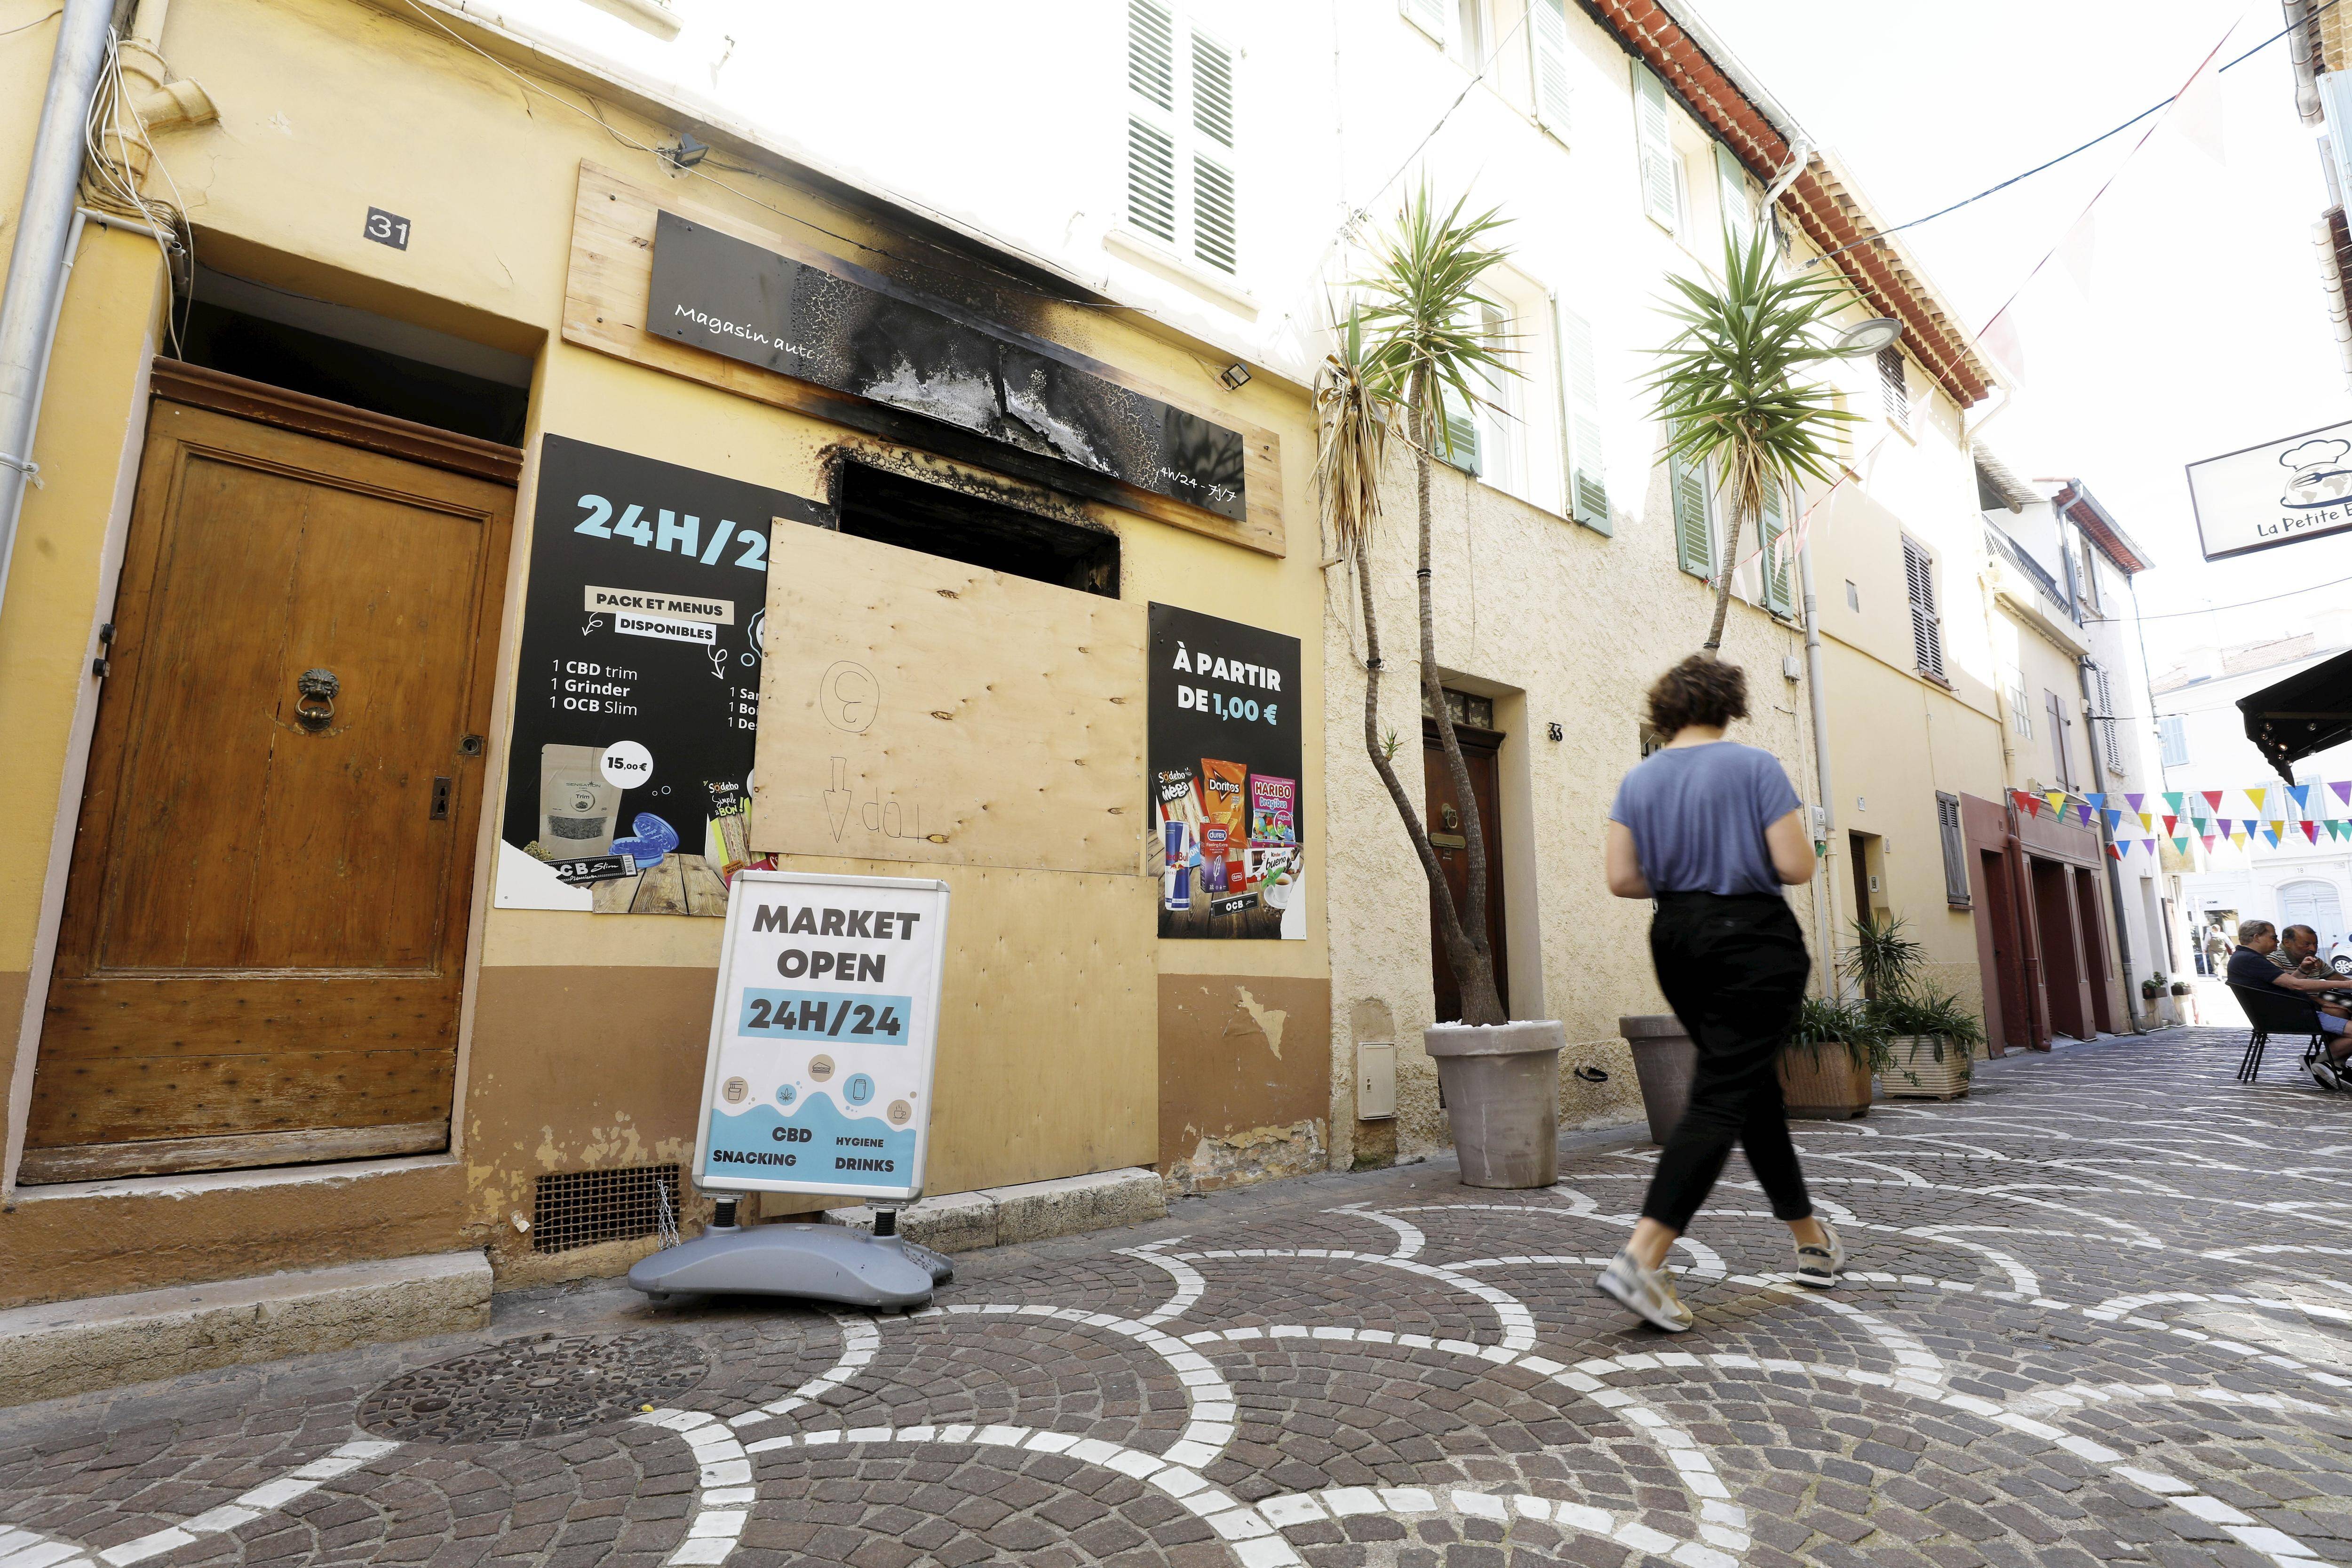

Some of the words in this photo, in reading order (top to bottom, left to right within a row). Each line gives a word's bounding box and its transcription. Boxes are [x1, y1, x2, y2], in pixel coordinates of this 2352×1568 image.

[369, 215, 407, 245] 31
[675, 303, 769, 344] Magasin
[774, 338, 816, 359] auto
[1160, 466, 1198, 489] 4h/24
[2257, 524, 2278, 537] La
[2282, 509, 2339, 532] Petite
[573, 493, 767, 572] 24H/2
[596, 593, 643, 610] PACK
[646, 597, 664, 611] ET
[667, 598, 723, 616] MENUS
[620, 618, 713, 640] DISPONIBLES
[553, 659, 559, 672] 1
[566, 661, 601, 676] CBD
[605, 662, 638, 681] trim
[1173, 640, 1192, 673] À
[1197, 652, 1281, 692] PARTIR
[551, 677, 557, 691] 1
[564, 679, 630, 697] Grinder
[730, 686, 735, 697] 1
[549, 695, 556, 708] 1
[563, 698, 599, 712] OCB
[604, 700, 637, 716] Slim
[729, 701, 734, 712] 1
[739, 703, 759, 715] Boi
[1178, 685, 1208, 712] DE
[1213, 693, 1259, 721] 1,00
[1263, 704, 1278, 725] €
[728, 716, 733, 727] 1
[738, 718, 758, 730] De
[1158, 770, 1185, 783] Sodebo
[708, 781, 739, 793] Sodebo
[1209, 779, 1240, 793] Doritos
[1255, 781, 1291, 799] HARIBO
[712, 792, 736, 808] Simple
[1260, 796, 1287, 810] Dragibus
[1178, 852, 1189, 861] Bull
[1265, 857, 1286, 870] bueno
[560, 863, 588, 876] CB
[590, 862, 619, 873] Slim
[726, 864, 744, 874] MOELLEUX
[1225, 899, 1243, 911] OCB
[752, 904, 921, 940] MARKET
[777, 948, 886, 983] OPEN
[747, 998, 901, 1036] 24H/24
[772, 1127, 812, 1143] CBD
[836, 1136, 884, 1148] HYGIENE
[713, 1149, 797, 1167] SNACKING
[835, 1157, 895, 1172] DRINKS
